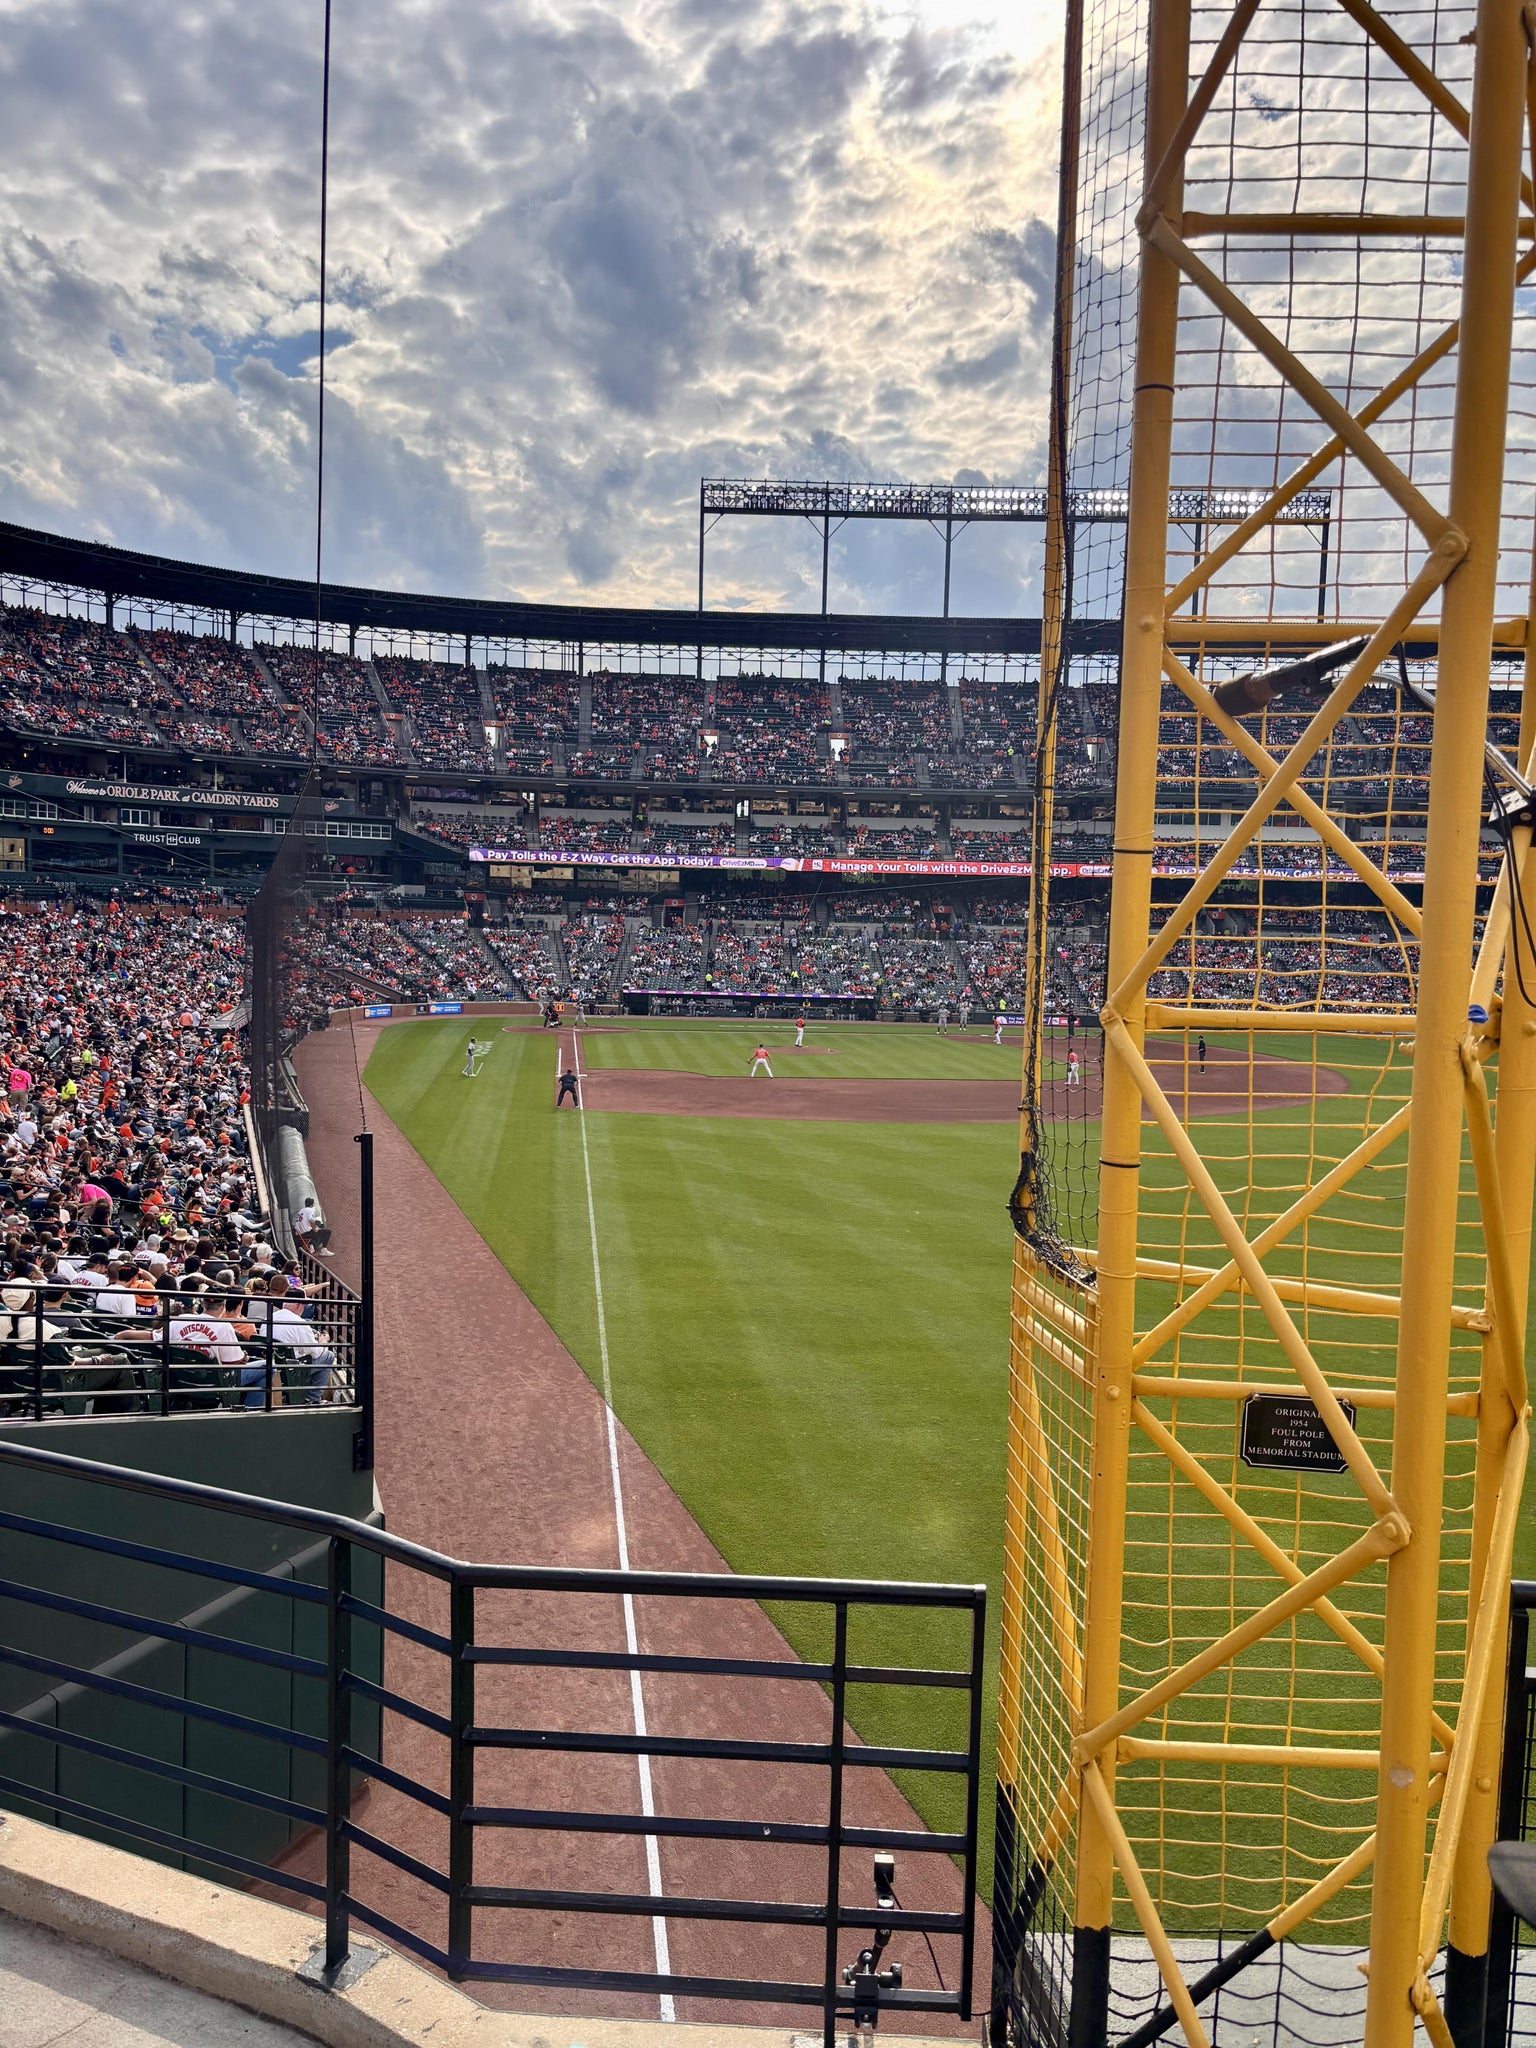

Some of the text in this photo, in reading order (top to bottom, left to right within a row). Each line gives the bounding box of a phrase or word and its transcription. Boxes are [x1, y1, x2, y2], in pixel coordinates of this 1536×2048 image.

[66, 780, 99, 795] Welcome
[99, 788, 107, 796] to
[107, 785, 149, 800] ORIOLE
[150, 789, 181, 802] PARK
[191, 792, 241, 805] CAMDEN
[242, 795, 279, 808] YARDS
[133, 833, 201, 844] TRUIST CLUB
[487, 850, 509, 861] Pay
[511, 851, 536, 861] Tolls
[538, 852, 558, 861] the
[560, 853, 579, 862] E-Z
[581, 854, 607, 865] Way.
[610, 854, 630, 864] Get
[631, 855, 652, 864] the
[653, 857, 676, 867] App
[677, 857, 714, 867] Today!
[831, 861, 874, 873] Manage
[876, 862, 901, 871] Your
[904, 863, 928, 872] Tolls
[931, 863, 957, 873] with
[959, 864, 978, 873] the
[980, 865, 1031, 874] DriveEzM
[179, 1323, 218, 1342] RUTSCHMAN
[1271, 1428, 1325, 1439] FOUL POLE
[1283, 1439, 1311, 1448] FROM
[1248, 1447, 1300, 1457] MEMORIAL
